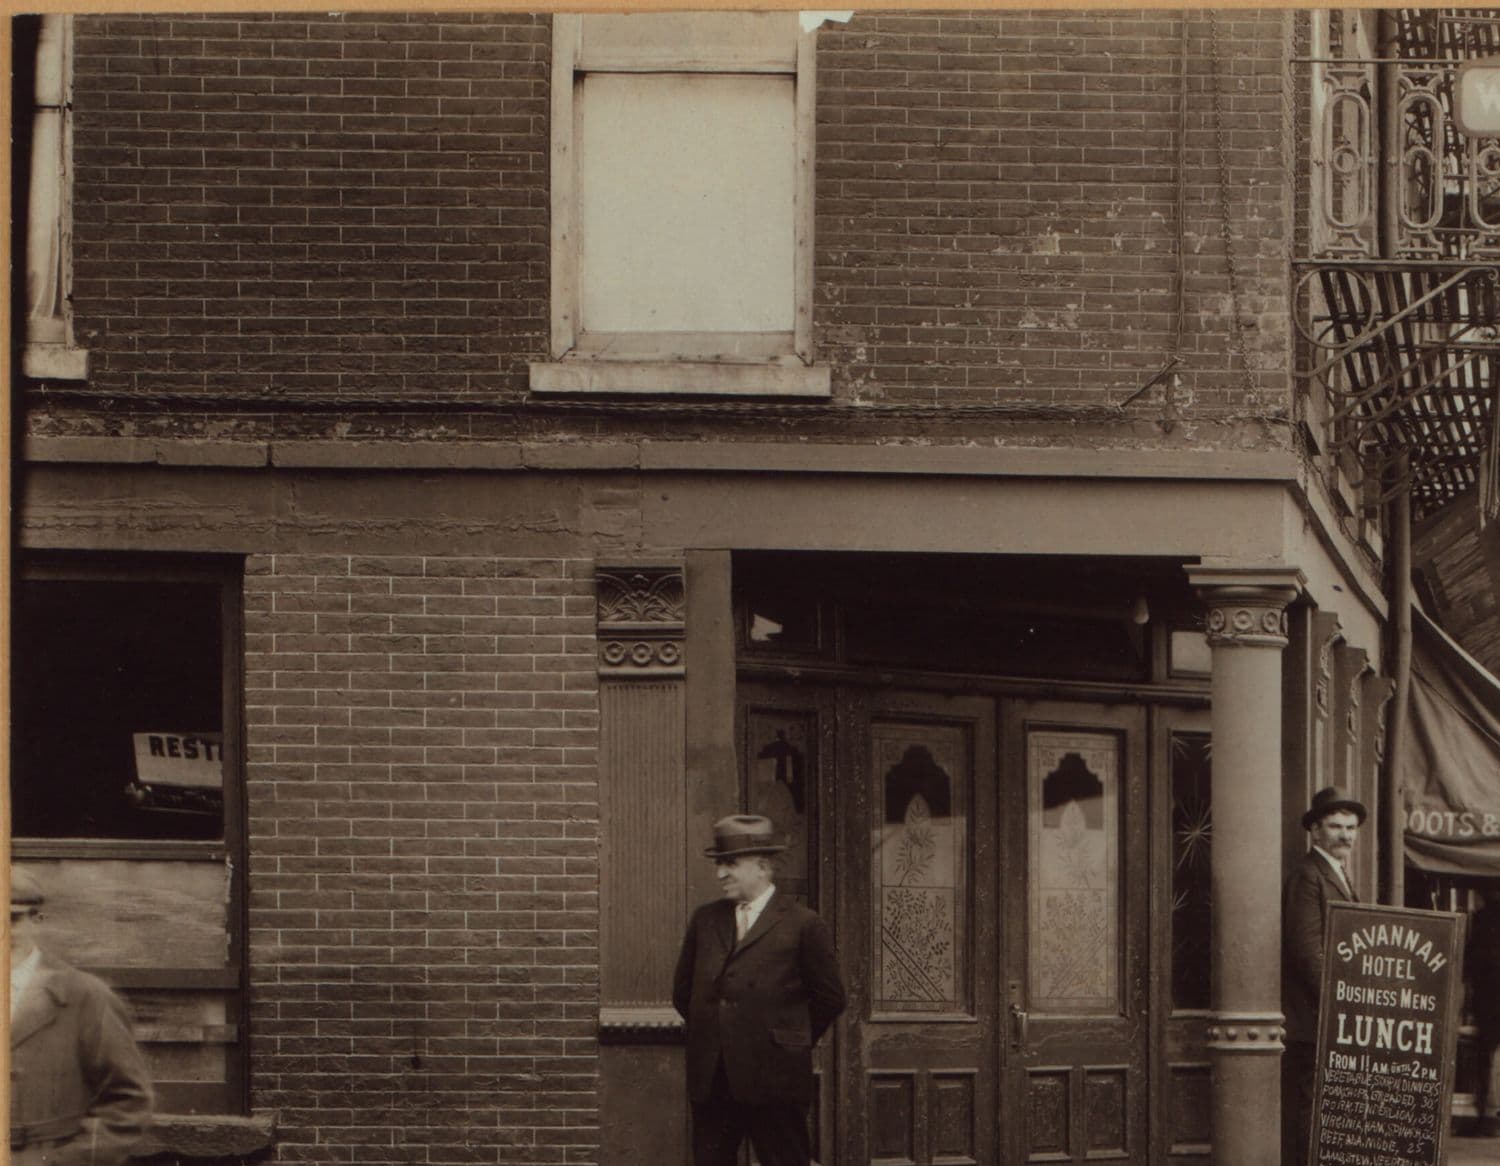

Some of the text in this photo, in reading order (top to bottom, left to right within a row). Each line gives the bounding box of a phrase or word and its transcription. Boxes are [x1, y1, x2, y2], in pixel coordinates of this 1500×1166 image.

[148, 735, 223, 762] REST
[1336, 923, 1447, 973] SAVANNAH
[1361, 954, 1416, 980] HOTEL
[1336, 980, 1437, 1012] BUSINESS MENS
[1336, 1013, 1434, 1055] LUNCH
[1329, 1050, 1357, 1071] FROM
[1411, 1060, 1421, 1079] 2
